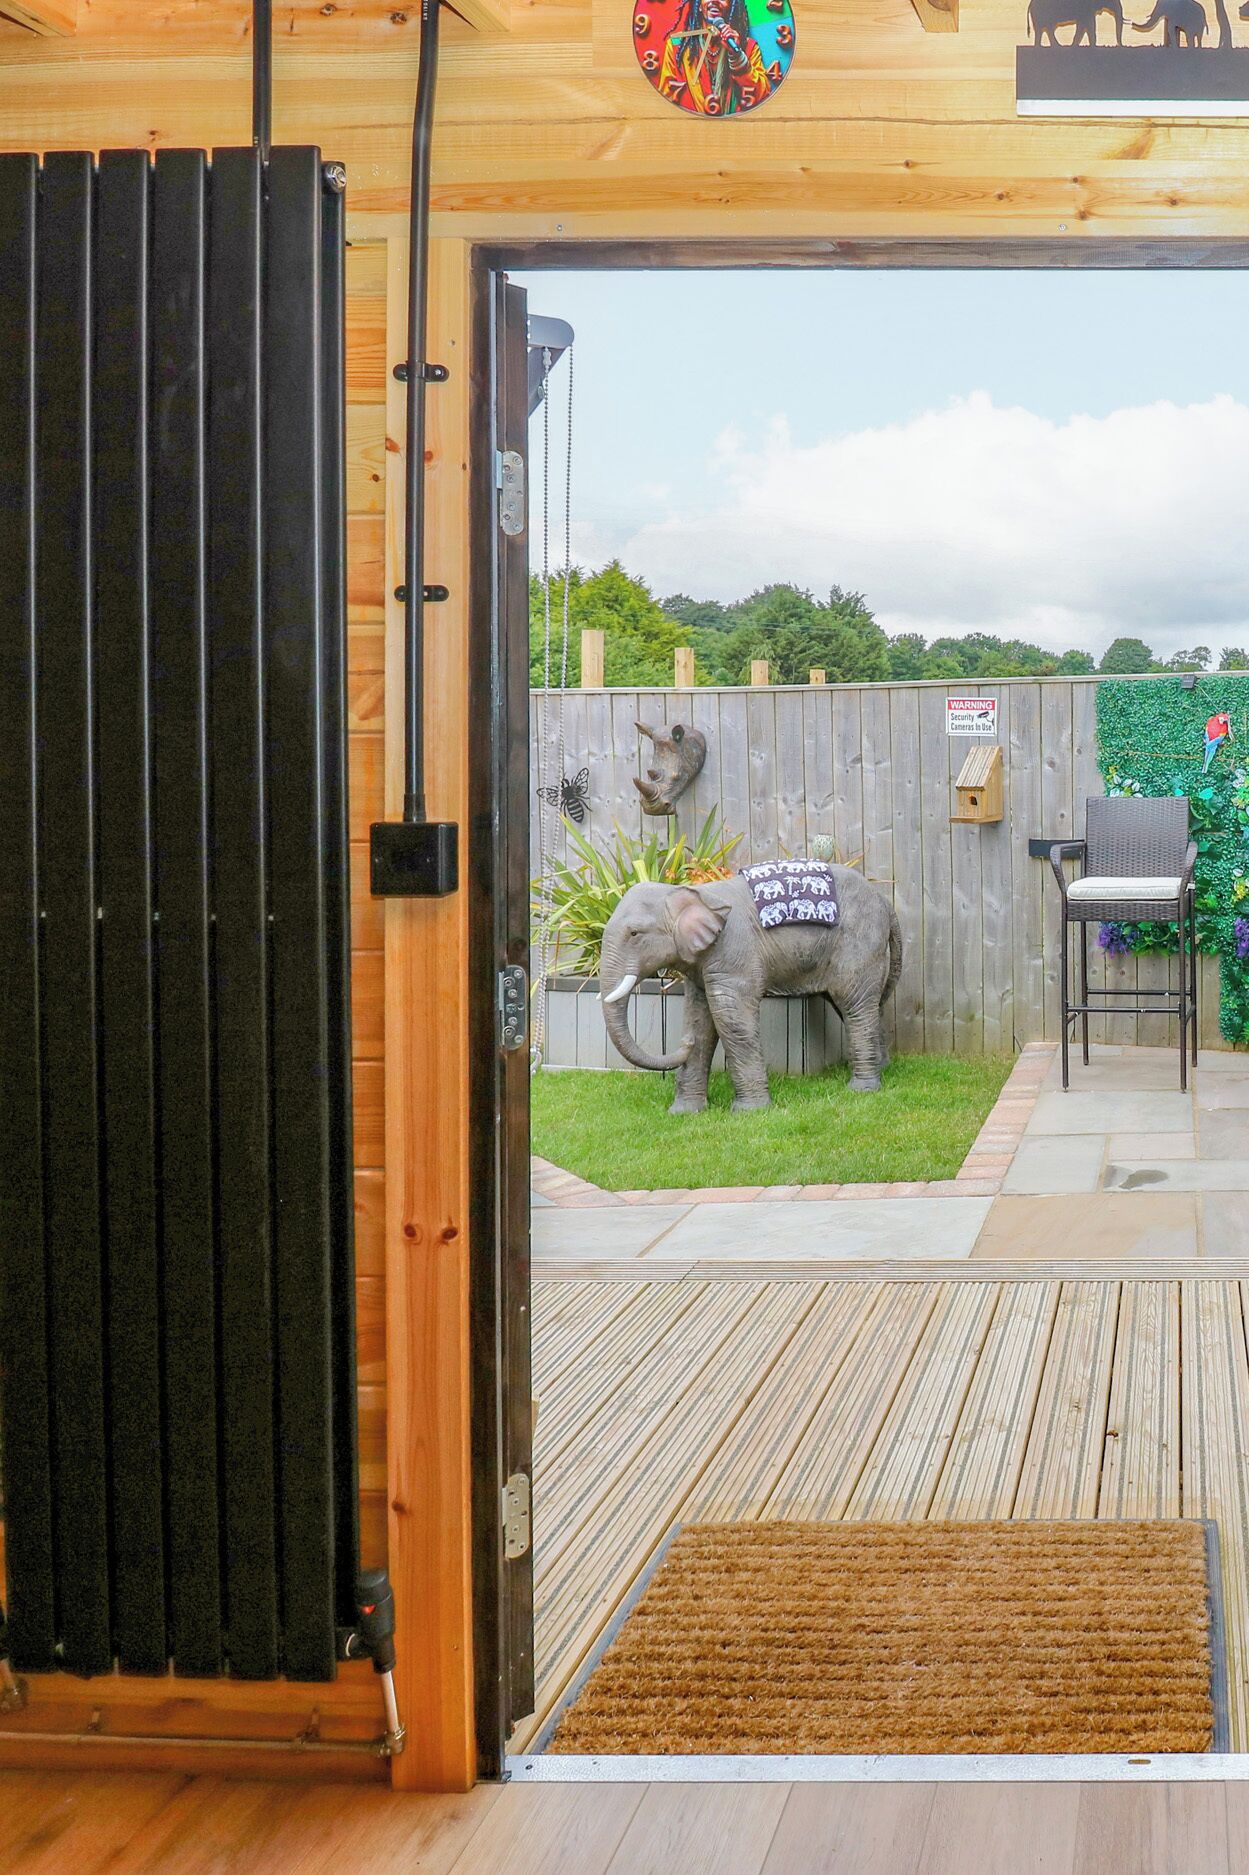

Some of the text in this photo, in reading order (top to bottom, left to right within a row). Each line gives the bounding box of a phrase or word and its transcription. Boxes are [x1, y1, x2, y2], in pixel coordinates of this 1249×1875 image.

[635, 14, 649, 33] 9
[777, 24, 792, 43] 3
[643, 50, 659, 70] 8
[766, 60, 782, 80] 4
[669, 80, 686, 100] 7
[741, 87, 756, 106] 5
[705, 94, 720, 114] 6
[950, 701, 993, 710] WARNING
[951, 713, 975, 722] Security
[951, 723, 992, 731] Cameras In Use
